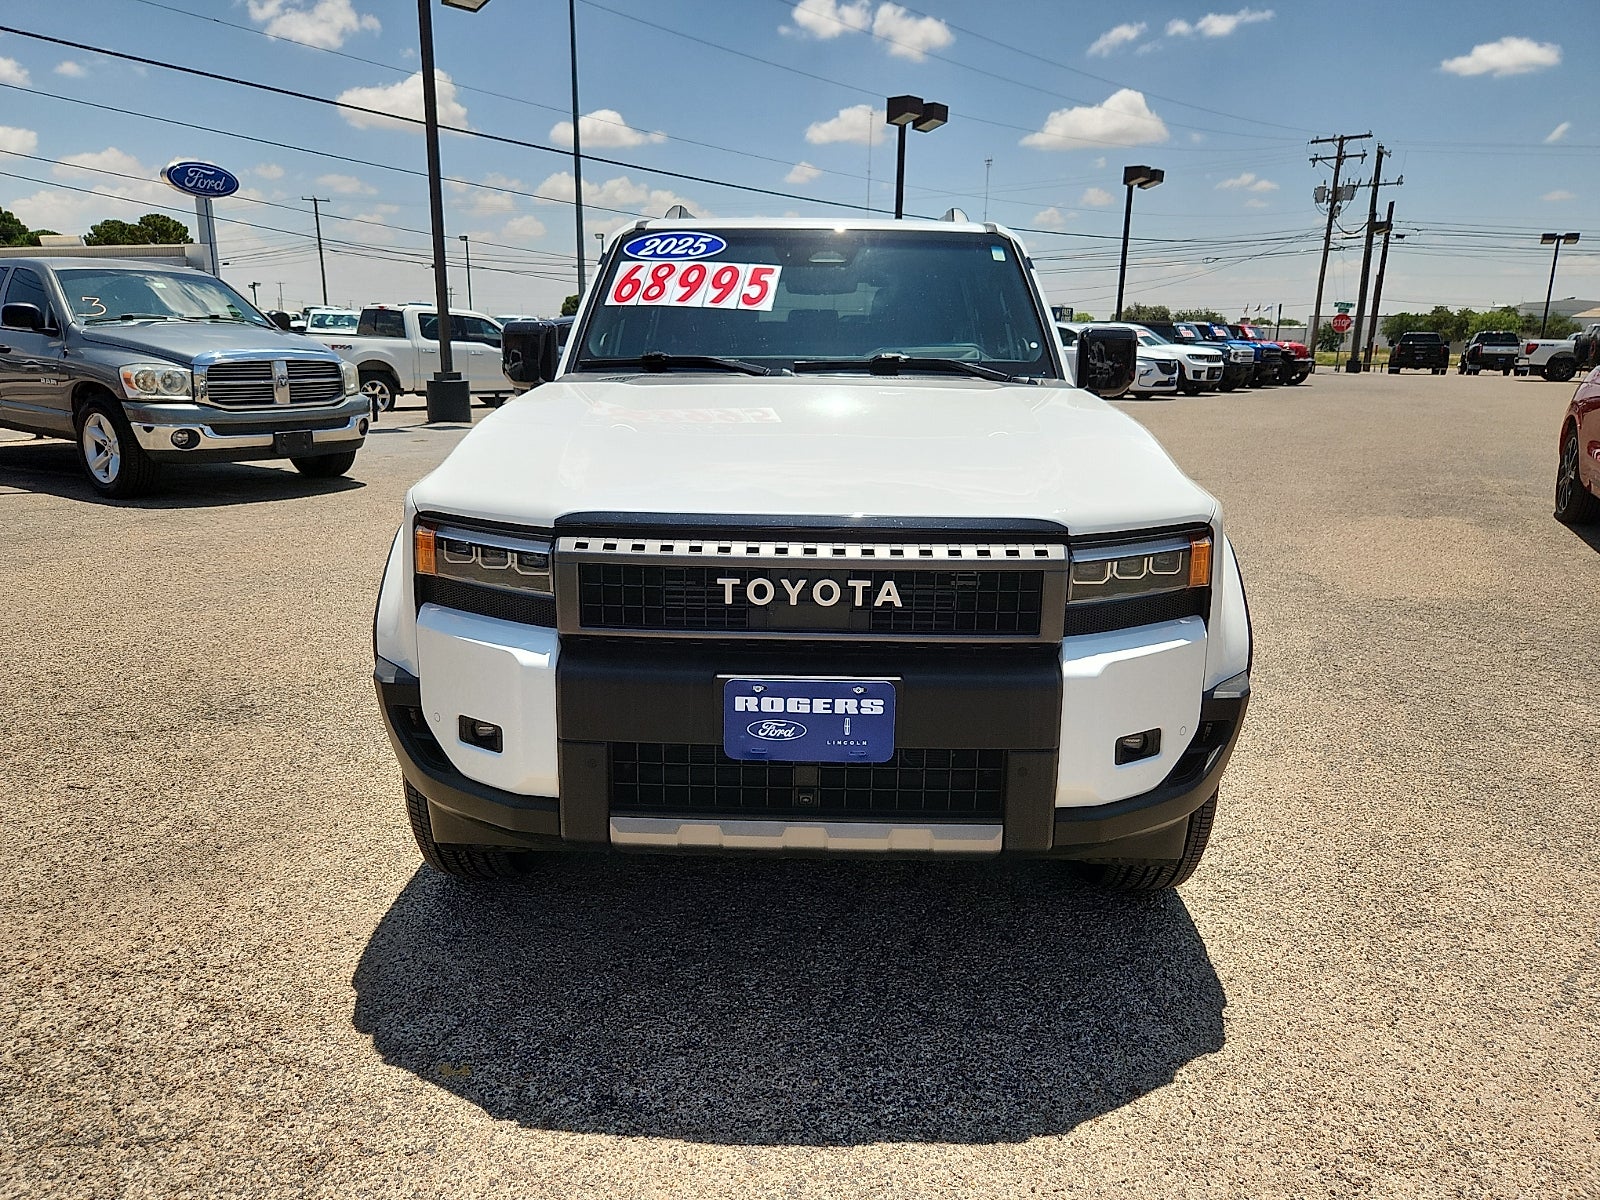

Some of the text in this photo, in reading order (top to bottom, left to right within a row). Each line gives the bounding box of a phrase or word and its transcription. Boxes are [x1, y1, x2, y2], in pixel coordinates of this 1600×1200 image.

[184, 168, 226, 191] Ford
[637, 237, 712, 256] 2025
[612, 263, 775, 306] 68995
[77, 296, 107, 317] 3
[1333, 319, 1351, 328] STOP
[716, 577, 903, 607] TOYOTA
[734, 696, 885, 715] ROGERS
[758, 722, 795, 738] Ford
